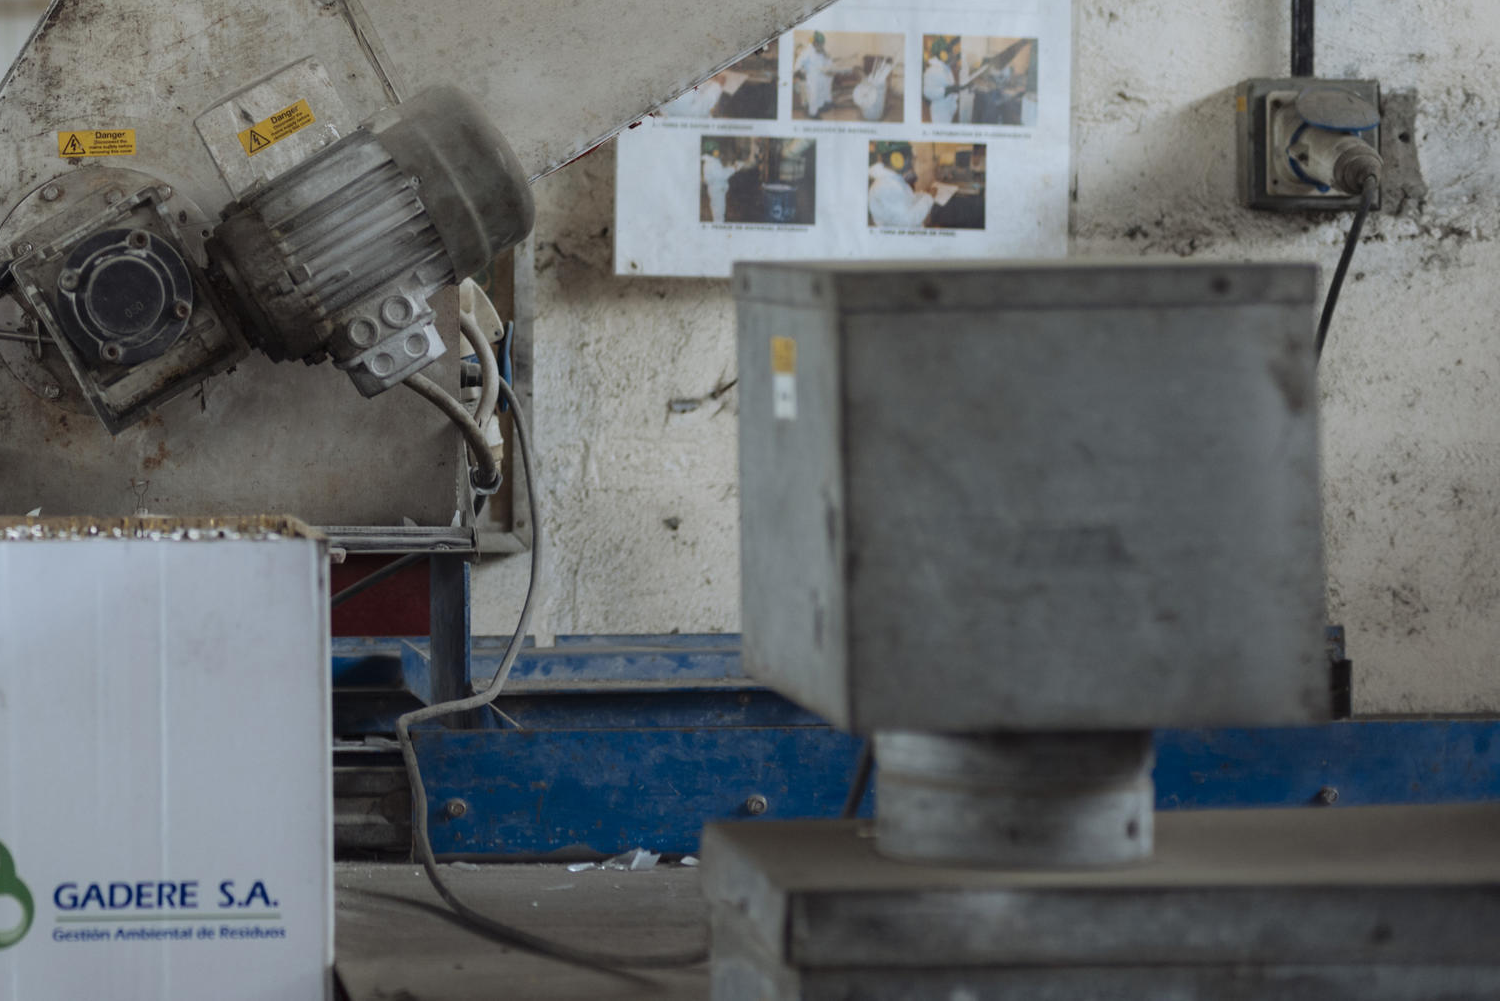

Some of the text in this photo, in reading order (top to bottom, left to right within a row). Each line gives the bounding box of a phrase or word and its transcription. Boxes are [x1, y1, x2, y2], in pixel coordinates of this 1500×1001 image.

[270, 105, 299, 124] Danger
[95, 131, 126, 140] Danger
[53, 880, 279, 910] GADERE S.A.
[52, 924, 286, 943] Gestión Ambiental de Residuos
